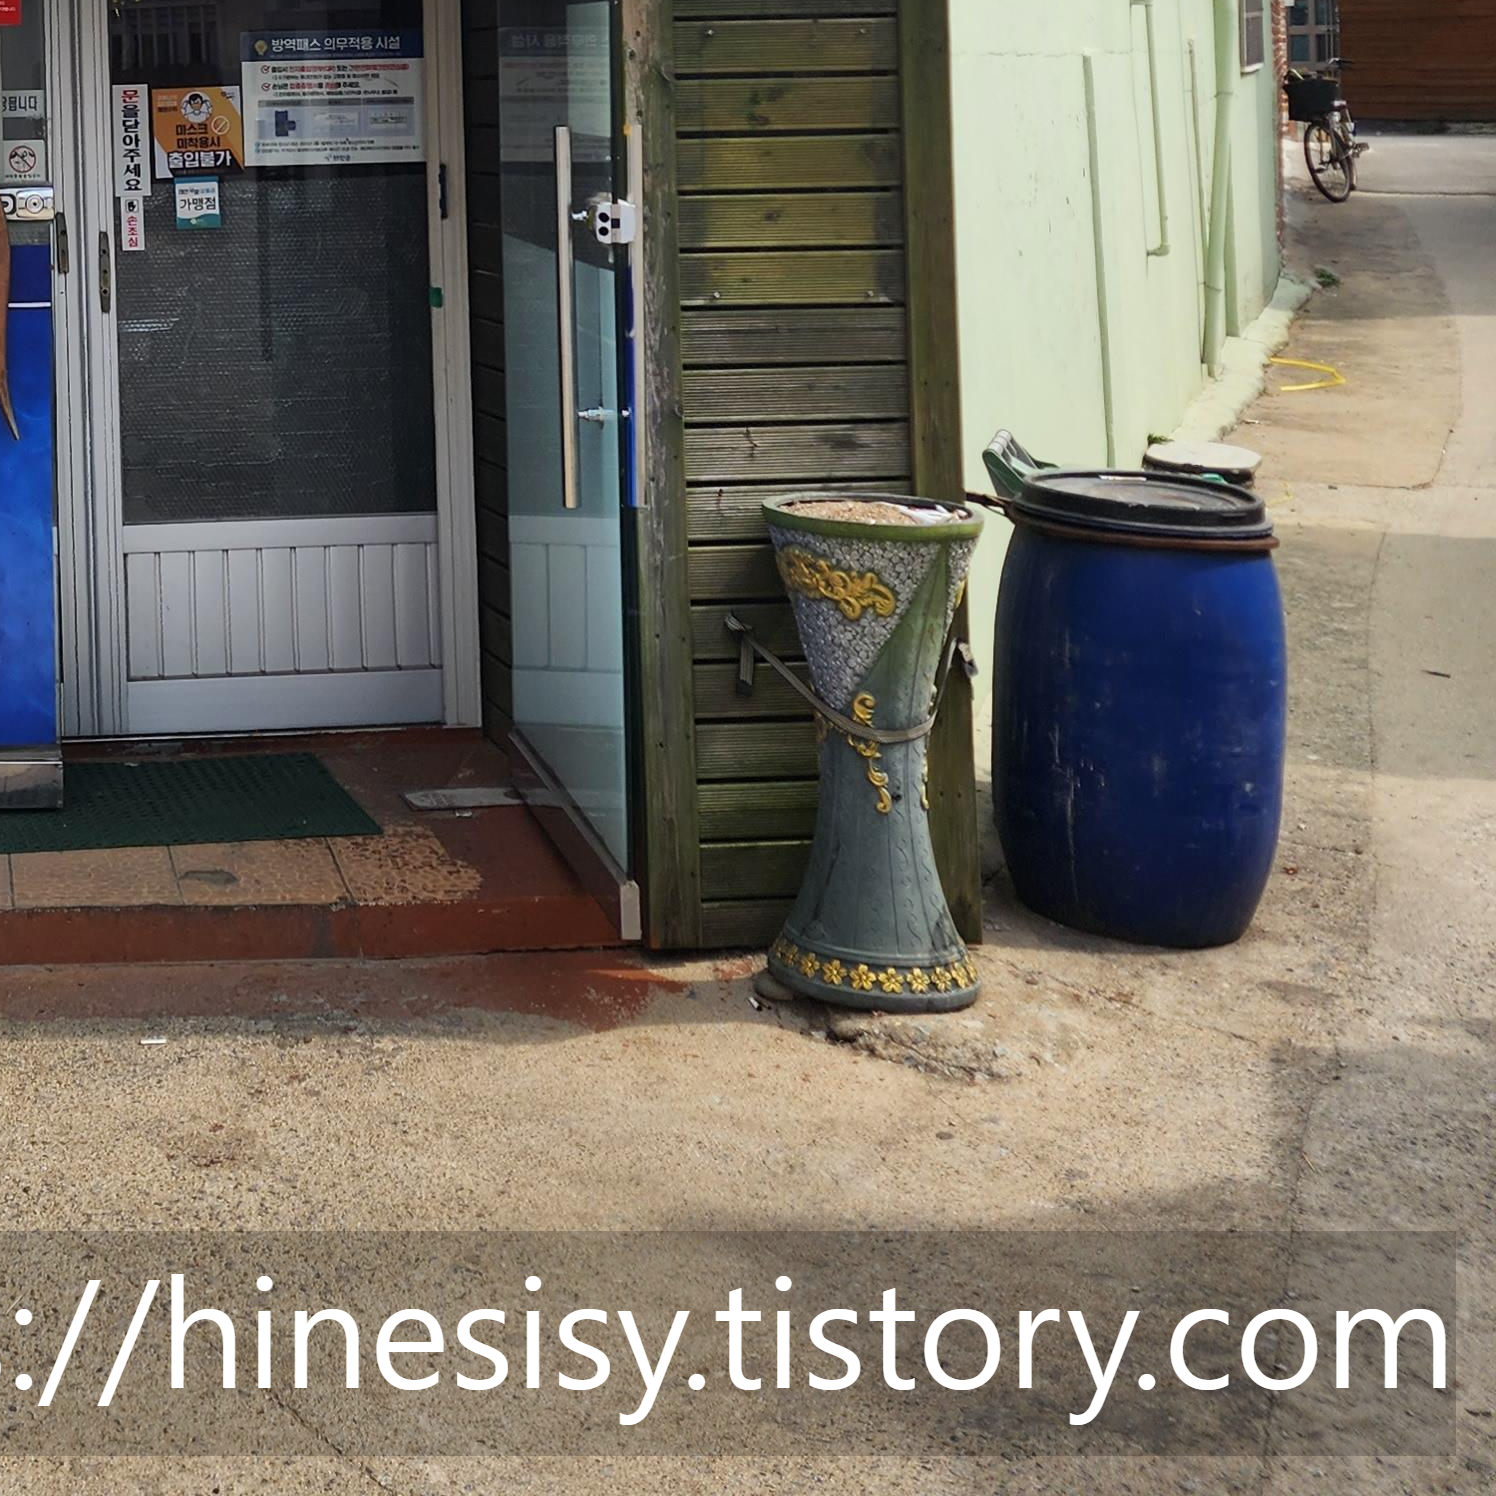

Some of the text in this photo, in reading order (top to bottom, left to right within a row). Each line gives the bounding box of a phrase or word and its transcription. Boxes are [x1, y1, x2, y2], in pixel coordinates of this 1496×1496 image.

[271, 35, 401, 51] 방역패스 의무적용 시설
[176, 123, 208, 136] 마스크
[177, 136, 221, 149] 미착용시
[168, 150, 232, 169] 출입불가
[179, 196, 216, 211] 가맹점
[127, 215, 139, 248] 손조심
